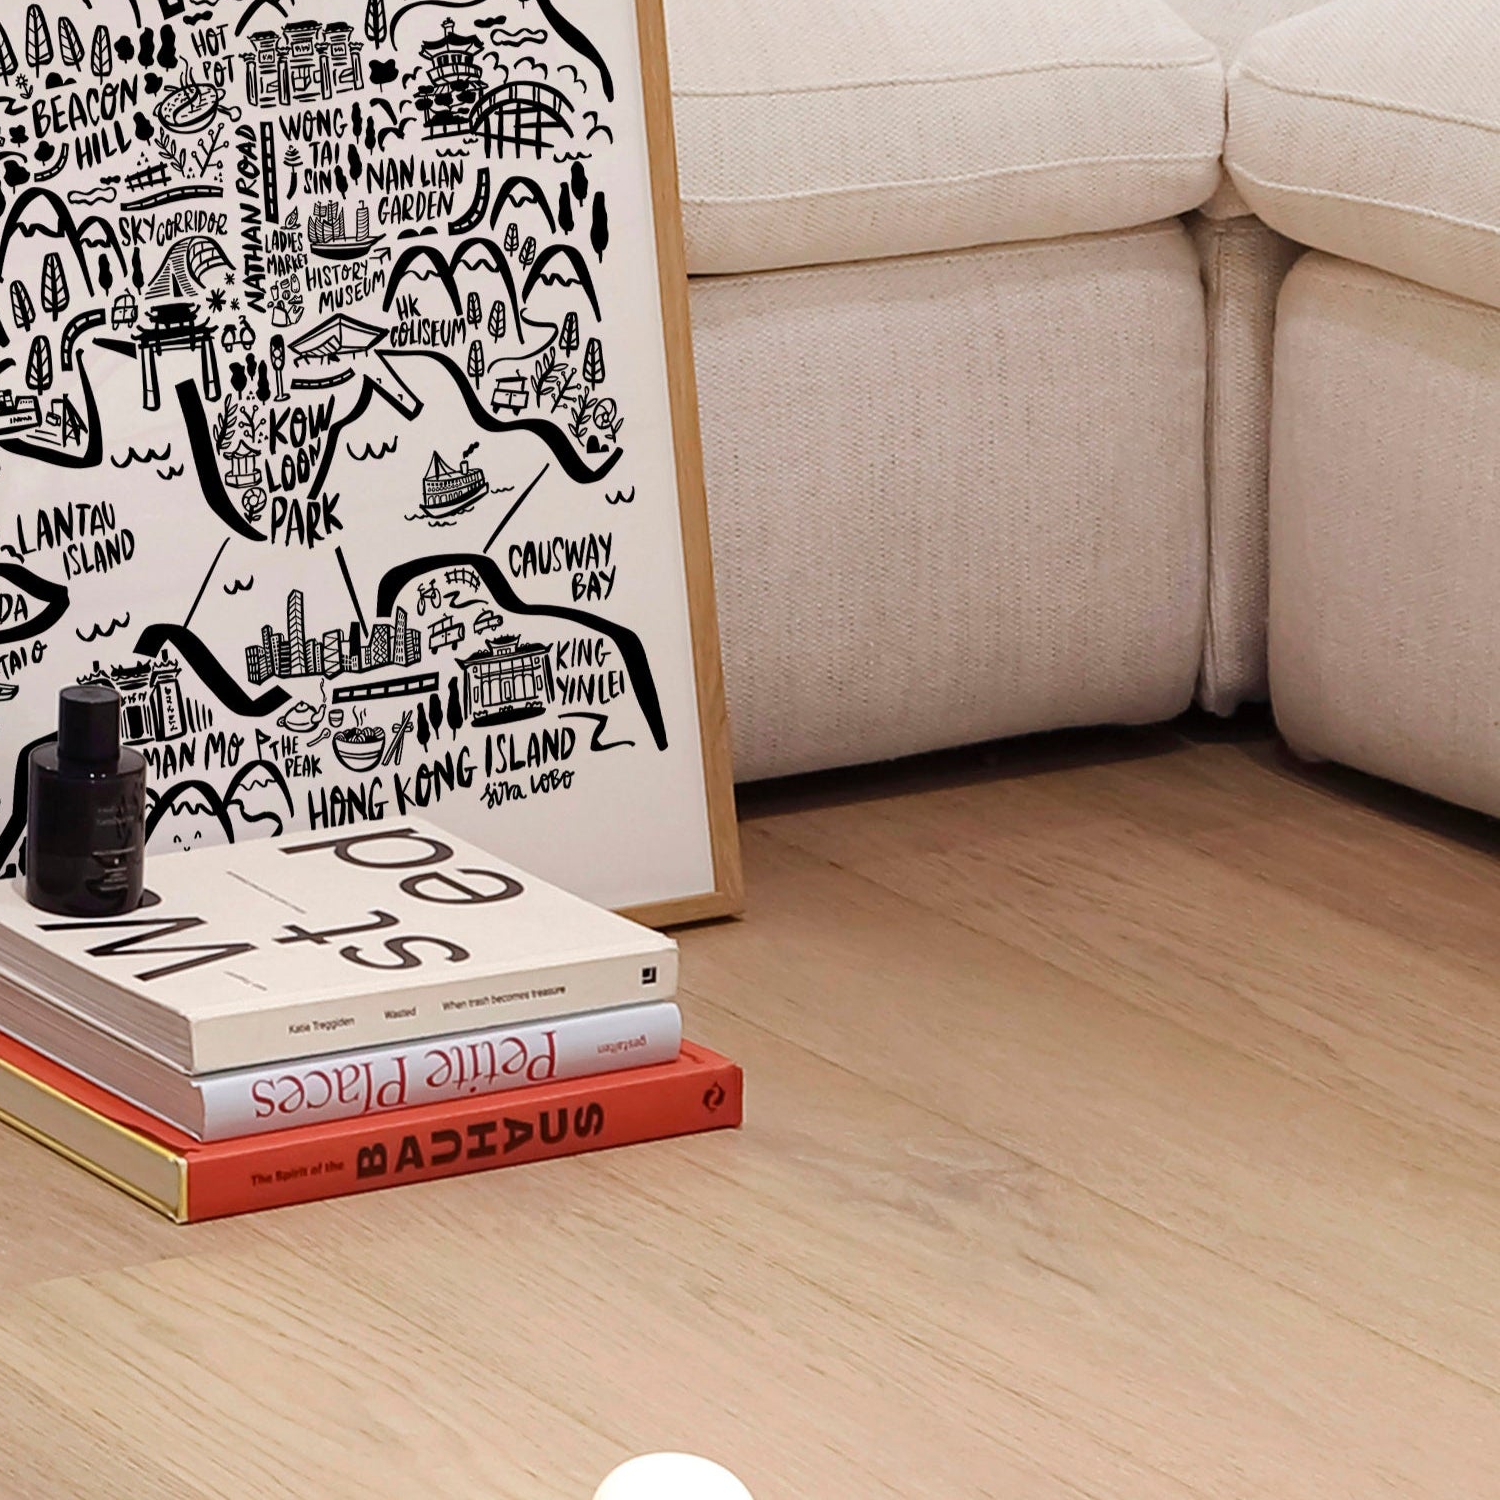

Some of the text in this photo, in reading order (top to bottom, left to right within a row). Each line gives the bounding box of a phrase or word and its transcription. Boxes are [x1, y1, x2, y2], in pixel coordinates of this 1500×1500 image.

[191, 24, 228, 58] HOT
[202, 54, 235, 88] POT
[32, 72, 138, 138] BEACON
[279, 108, 348, 142] WONG
[74, 120, 132, 170] HILL
[308, 140, 340, 168] TAI
[303, 168, 332, 195] SIN
[366, 155, 464, 194] NAN LIAN
[234, 124, 268, 314] NATHAN ROAD
[377, 191, 455, 226] GARDEN
[119, 209, 228, 247] SKY CORRIDOR
[264, 229, 304, 254] LADIES
[266, 253, 309, 278] MARKET
[305, 259, 369, 292] HISTORY
[317, 267, 387, 315] MUSEUM
[396, 294, 422, 322] HK
[389, 317, 467, 349] COLISEUM
[269, 393, 336, 456] KOW
[266, 437, 322, 494] LOON
[16, 500, 117, 556] LANTAU
[271, 492, 344, 550] PARK
[62, 528, 135, 581] ISLAND
[508, 532, 613, 579] CAUSWAY
[571, 564, 617, 602] BAY
[30, 639, 48, 664] O
[556, 637, 612, 672] KING
[555, 670, 625, 706] YIN LEI
[143, 731, 245, 780] MAN MO
[268, 734, 299, 762] THE
[284, 754, 323, 779] PEAK
[307, 726, 576, 831] HONG KONG ISLAND
[384, 1005, 417, 1021] Wasted
[442, 998, 467, 1012] When
[467, 995, 490, 1008] trash
[490, 991, 530, 1006] becomes
[530, 985, 567, 1000] treasure
[596, 1032, 649, 1056] gestalten
[250, 1029, 559, 1118] Petite Places
[250, 1101, 606, 1187] The Spirit of the BAUHAUS
